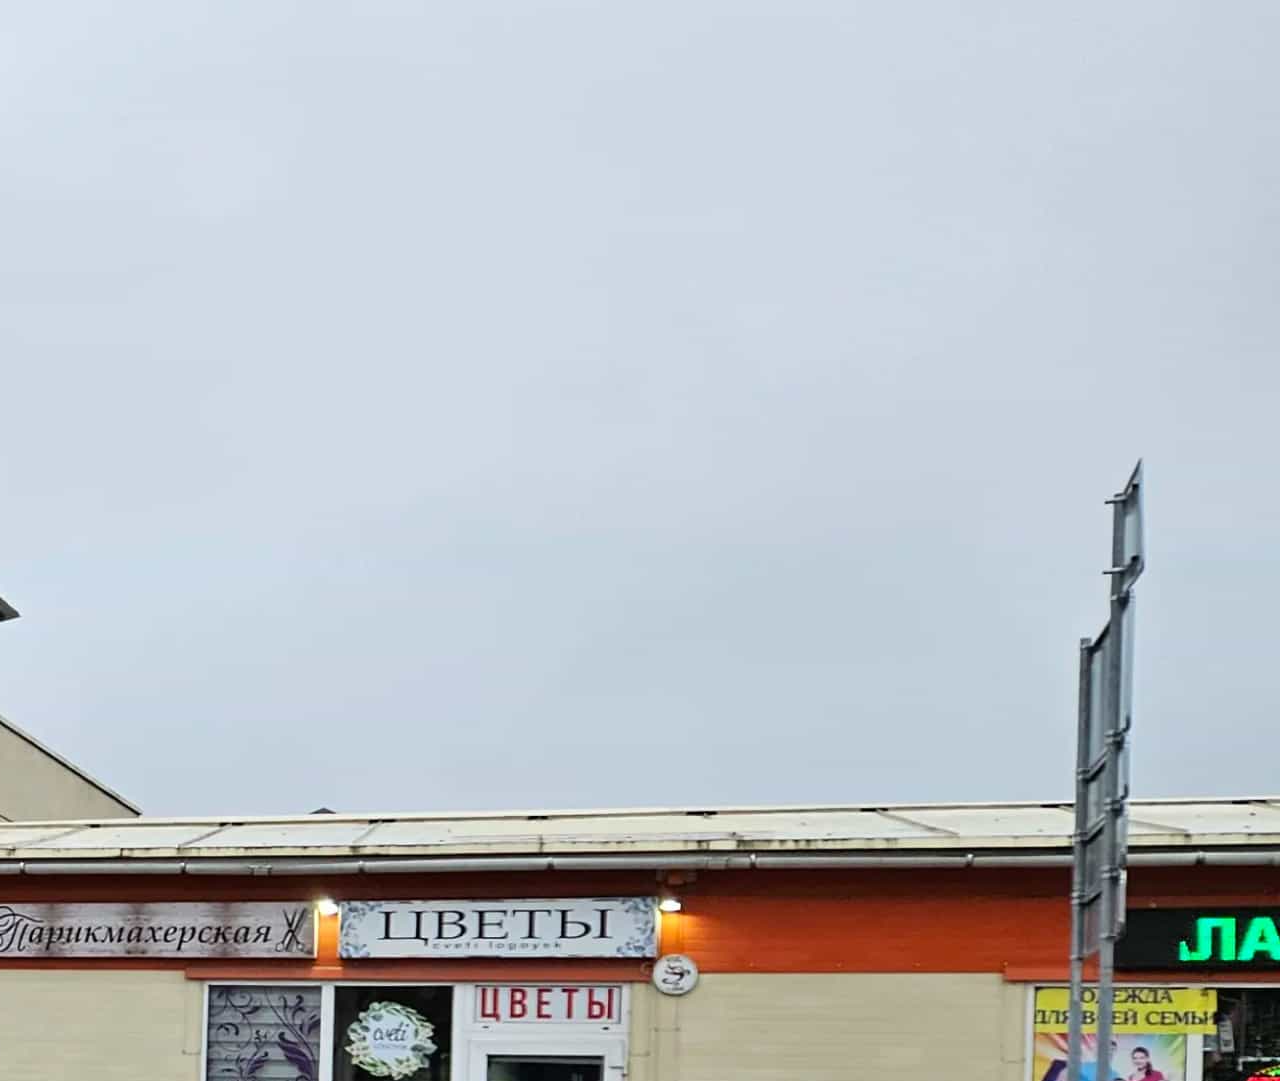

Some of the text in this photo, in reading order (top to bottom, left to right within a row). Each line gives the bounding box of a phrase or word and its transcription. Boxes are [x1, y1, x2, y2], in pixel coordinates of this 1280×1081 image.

[378, 908, 615, 947] ЦВЕТЫ
[480, 988, 616, 1022] ЦВЕТЫ
[1081, 987, 1174, 1005] ОЕЖДА
[1081, 1008, 1138, 1025] ВЕЙ
